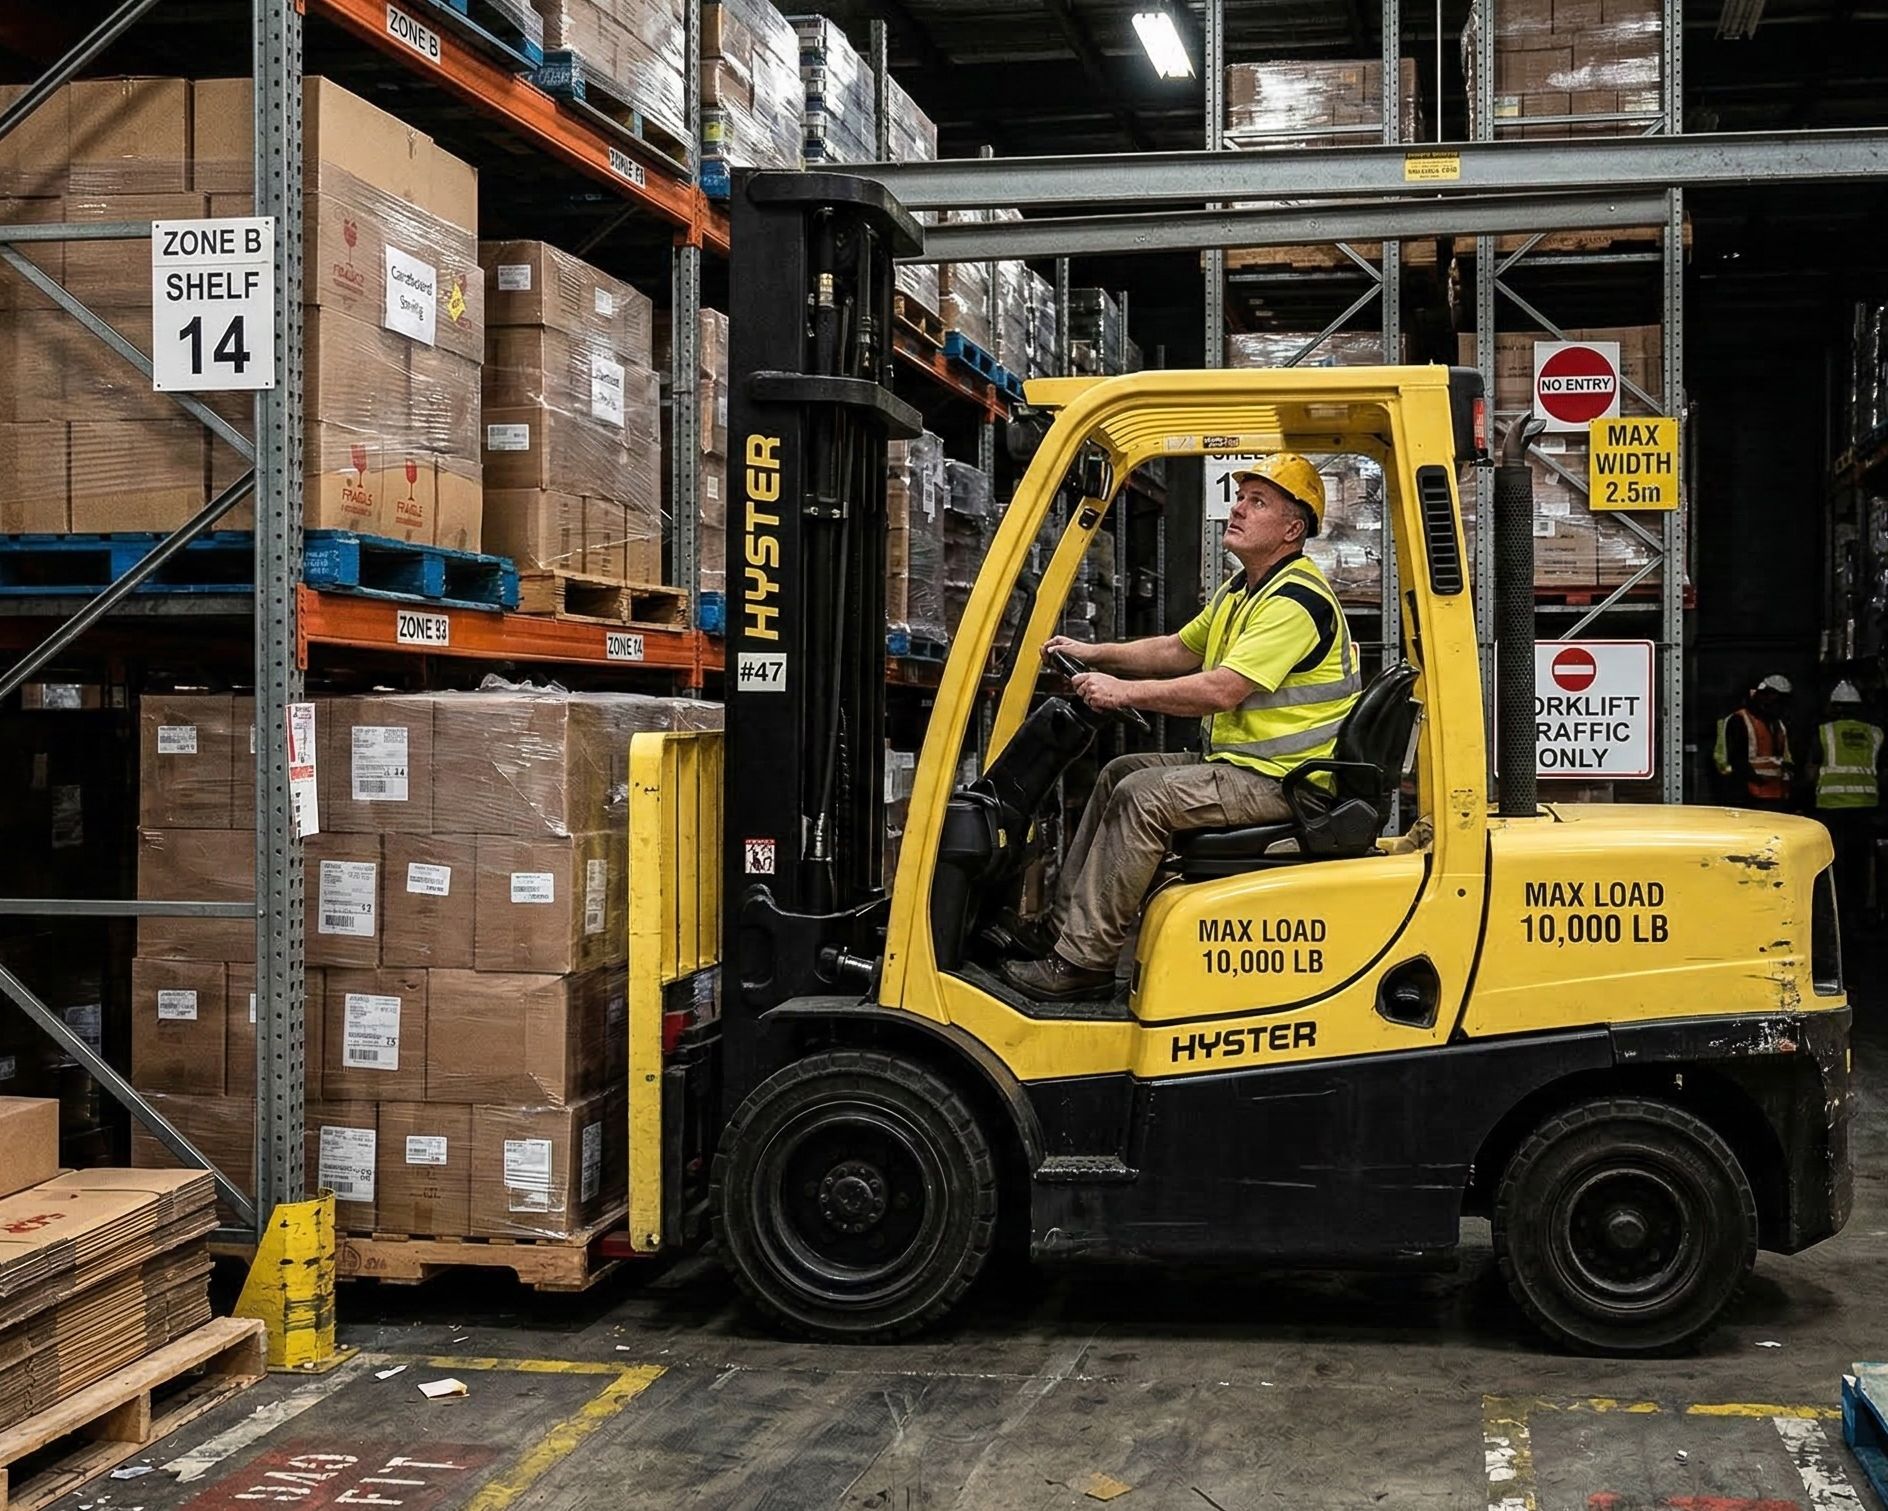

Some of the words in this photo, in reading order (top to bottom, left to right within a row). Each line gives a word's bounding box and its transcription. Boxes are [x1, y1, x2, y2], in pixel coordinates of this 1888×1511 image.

[390, 9, 426, 51] ZONE
[429, 35, 438, 57] B
[163, 229, 235, 256] ZONE
[245, 228, 262, 254] B
[166, 271, 260, 302] SHELF
[179, 315, 251, 375] 14
[1541, 379, 1562, 392] NO
[1566, 377, 1612, 391] ENTRY
[1608, 424, 1660, 447] MAX
[1595, 452, 1671, 475] WIDTH
[1606, 481, 1661, 503] 2.5m
[744, 434, 781, 641] HYSTER
[400, 615, 432, 640] ZONE
[608, 636, 632, 656] ZONE
[740, 661, 784, 682] #47
[1535, 696, 1640, 717] ORKLIFT
[1536, 721, 1631, 742] RAFFIC
[1538, 748, 1609, 768] ONLY
[1525, 881, 1585, 908] MAX
[1594, 881, 1665, 908] LOAD
[1199, 919, 1253, 943] MAX
[1262, 919, 1326, 943] LOAD
[1520, 914, 1621, 948] 10,000
[1633, 914, 1669, 943] LB
[1202, 949, 1284, 978] 10,000
[1294, 949, 1324, 973] LB
[1171, 1021, 1317, 1063] HYSTER
